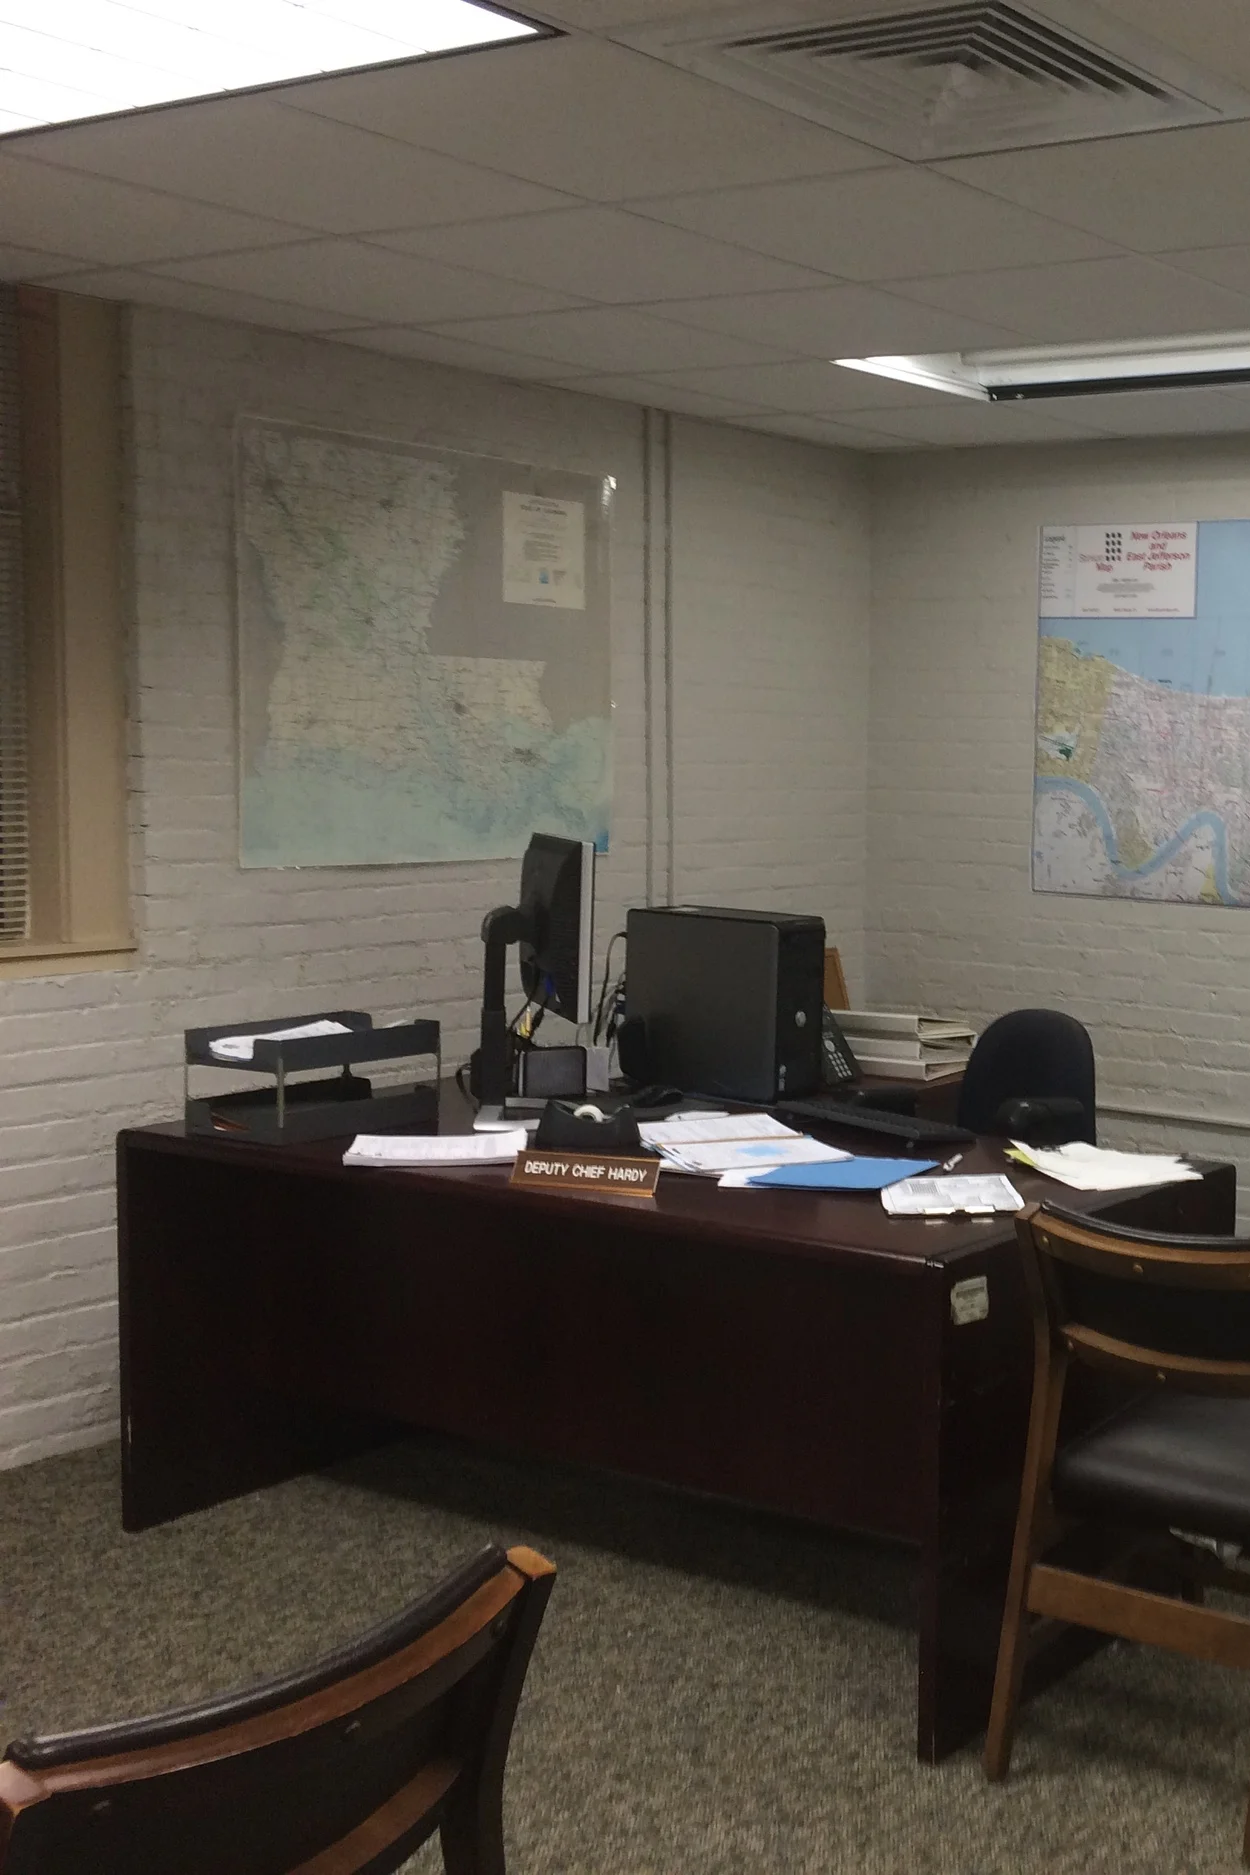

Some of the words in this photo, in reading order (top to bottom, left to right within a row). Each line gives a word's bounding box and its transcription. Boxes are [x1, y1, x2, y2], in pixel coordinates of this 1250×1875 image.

[1131, 531, 1148, 541] New
[1151, 530, 1187, 540] Orleans
[1149, 542, 1167, 551] and
[1126, 552, 1147, 561] East
[1143, 561, 1172, 571] Parish
[524, 1160, 569, 1176] DEPUTY
[572, 1165, 606, 1179] CHIEF
[608, 1166, 648, 1182] HARDY
